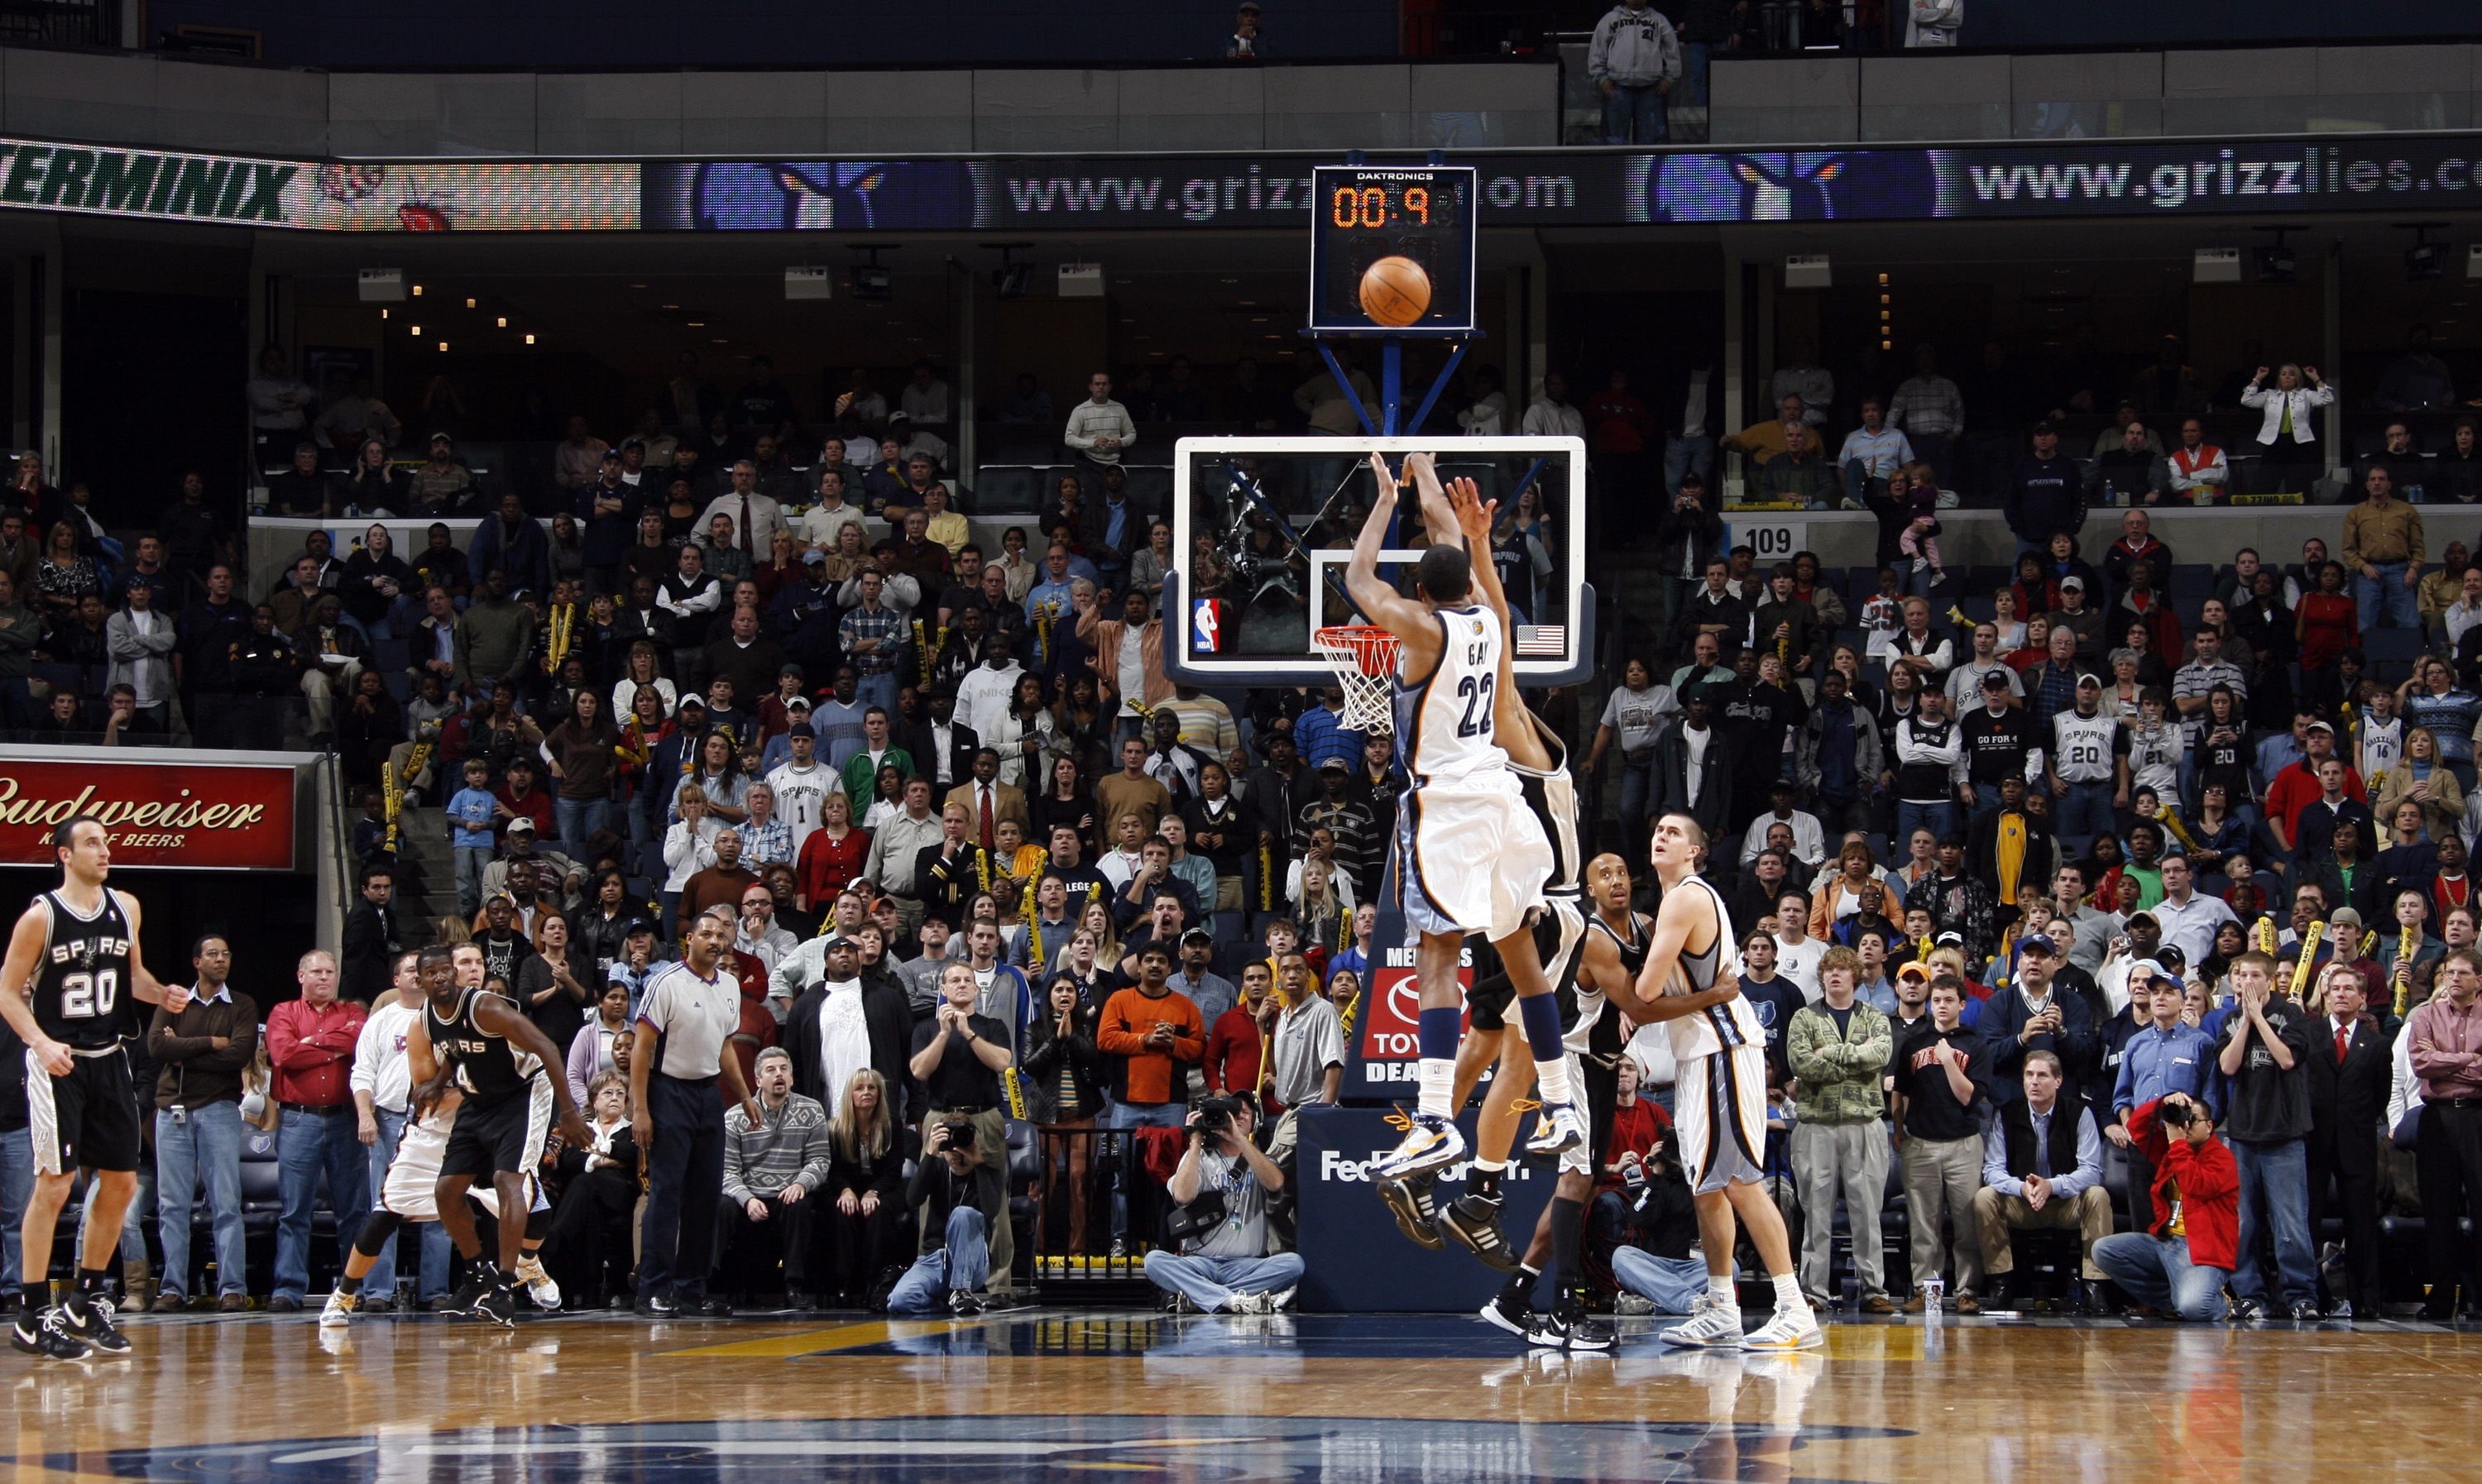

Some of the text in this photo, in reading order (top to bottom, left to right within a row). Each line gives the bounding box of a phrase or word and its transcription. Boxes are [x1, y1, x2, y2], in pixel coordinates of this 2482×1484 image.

[1357, 172, 1434, 181] DAKTRONICS
[1747, 528, 1791, 554] 109
[1196, 641, 1210, 650] NBA
[1469, 642, 1489, 667] GAY
[1458, 672, 1494, 739] 22
[1978, 735, 1990, 744] GO
[1992, 735, 2010, 744] FOR
[2065, 730, 2106, 742] SPURS
[2072, 746, 2099, 764] 20
[2145, 750, 2163, 765] 21
[2215, 749, 2235, 764] 20
[2377, 744, 2389, 759] 16
[782, 786, 821, 799] SPURS
[798, 806, 806, 824] 1
[52, 936, 129, 965] SPURS
[62, 969, 118, 1018] 20
[1010, 1074, 1025, 1118] ANY SPACE
